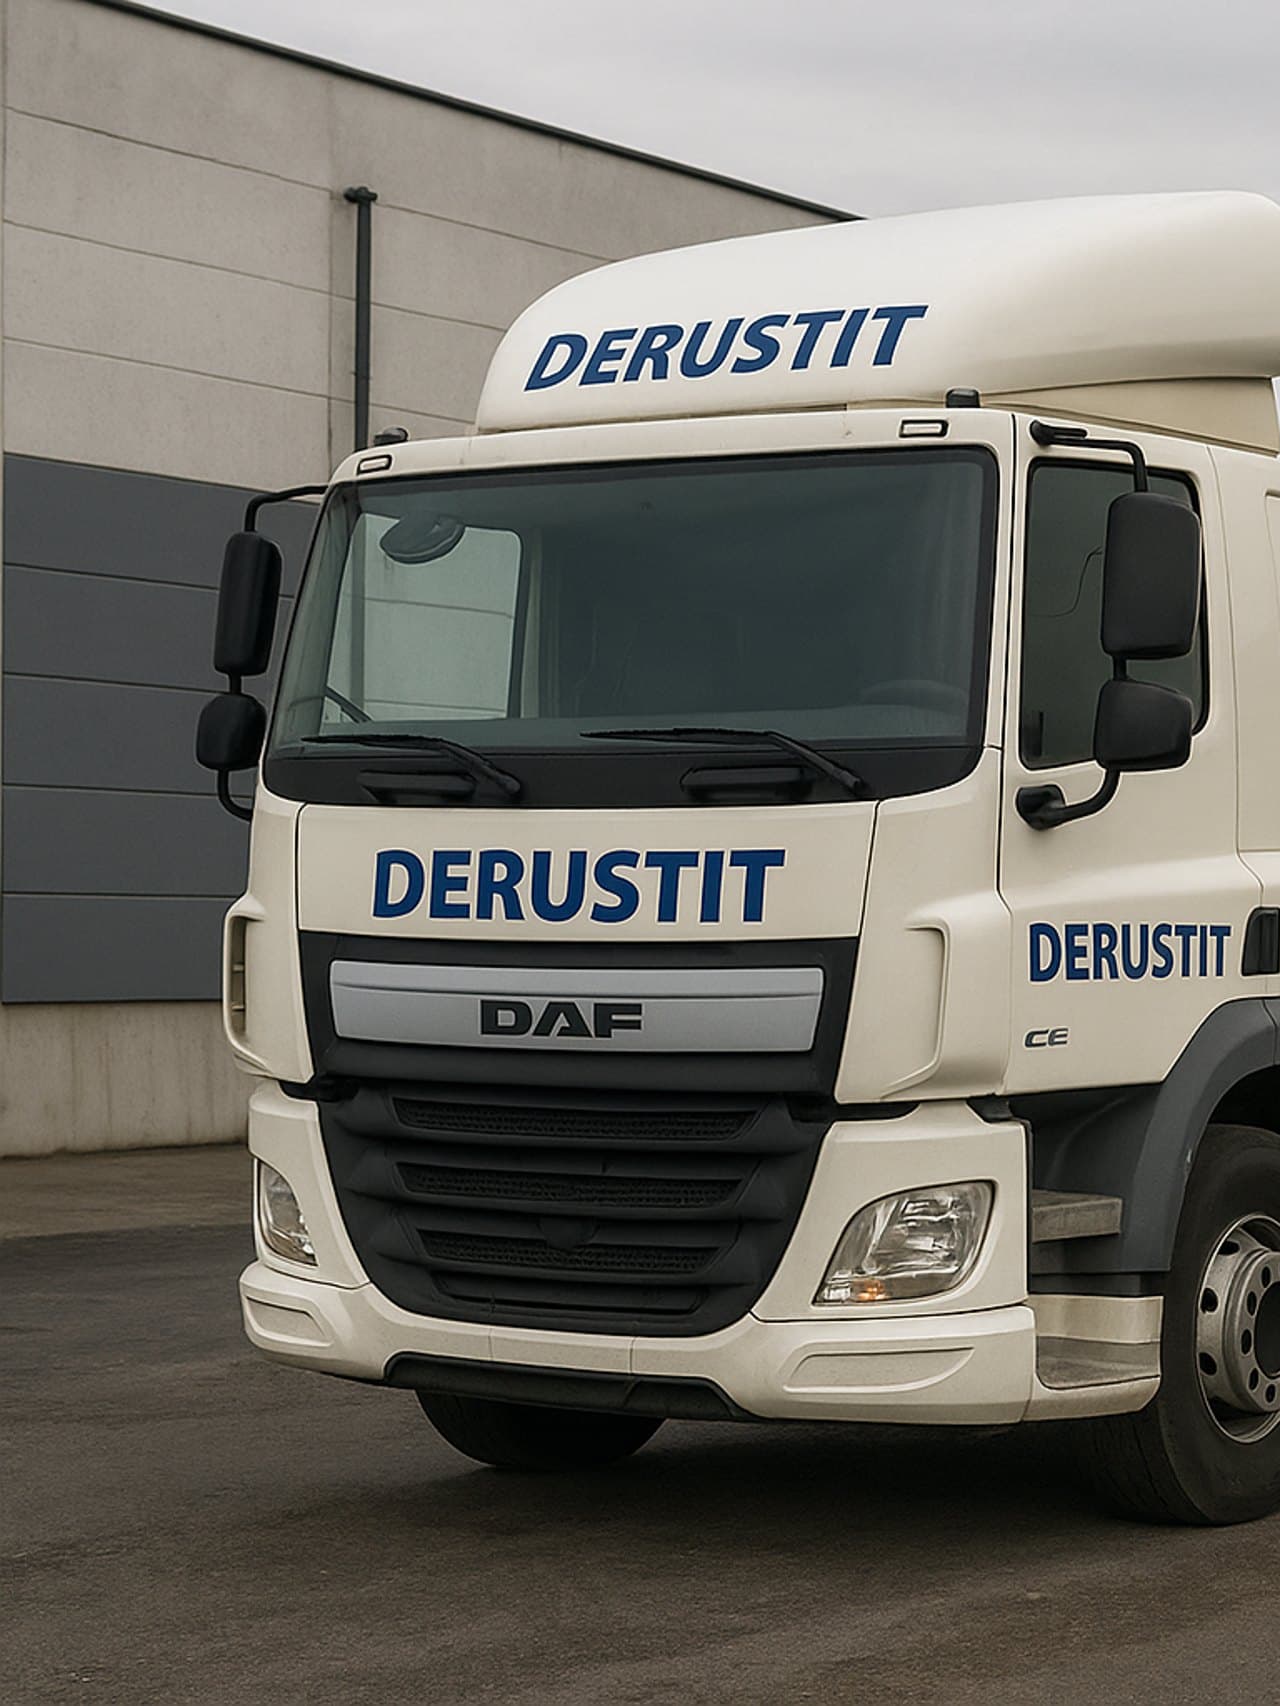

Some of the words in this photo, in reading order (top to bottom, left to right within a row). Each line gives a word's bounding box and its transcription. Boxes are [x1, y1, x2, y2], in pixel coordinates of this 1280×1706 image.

[524, 305, 928, 390] DERUSTIT
[373, 849, 786, 923] DERUSTIT
[1029, 922, 1231, 982] DERUSTIT
[480, 999, 642, 1038] DAF
[1024, 1027, 1069, 1048] CE
